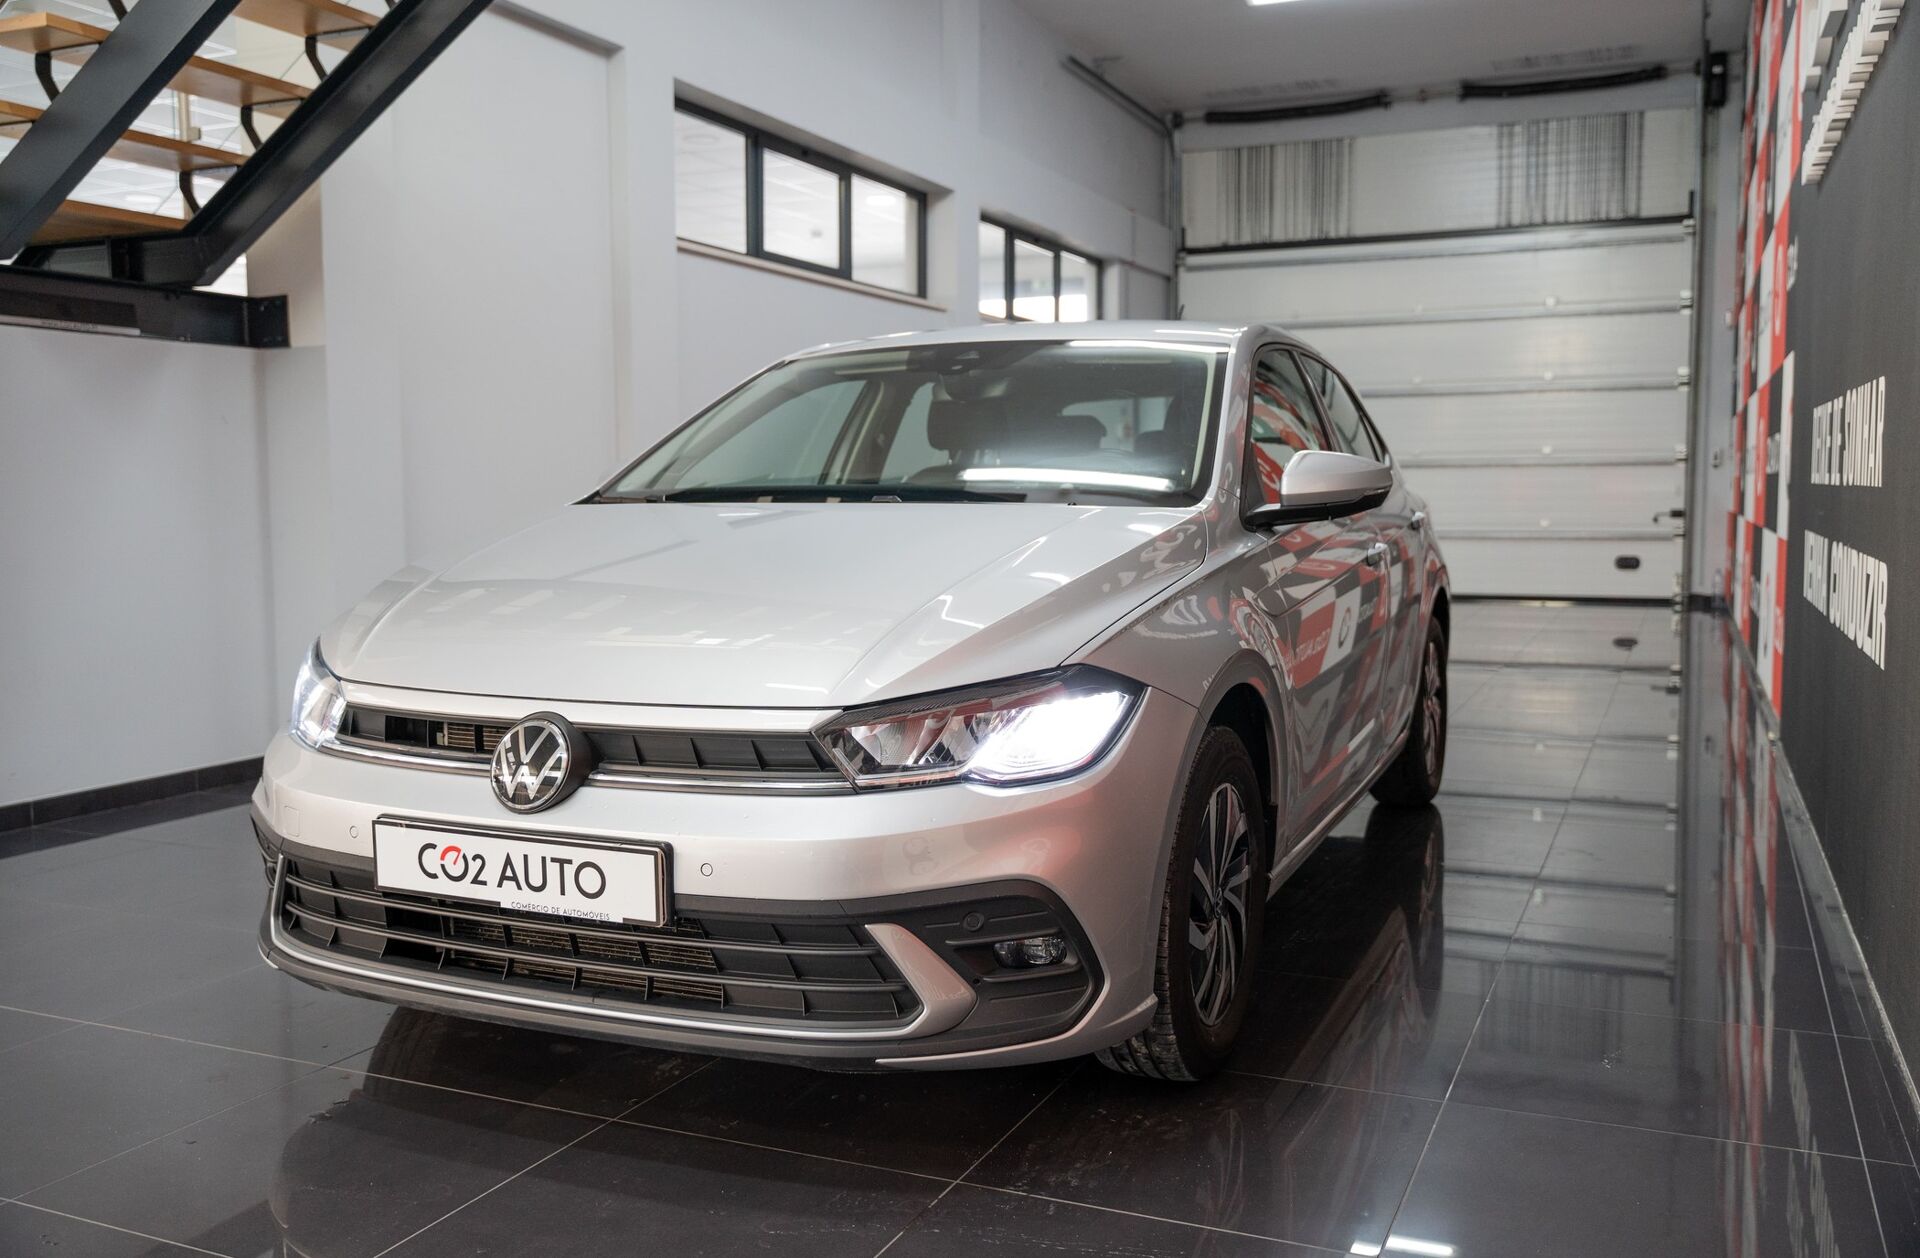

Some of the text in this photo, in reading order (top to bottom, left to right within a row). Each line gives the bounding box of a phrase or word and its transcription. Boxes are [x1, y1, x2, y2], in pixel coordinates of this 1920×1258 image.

[1843, 376, 1886, 487] SONHAR
[1829, 541, 1888, 671] CONDUZIR
[418, 842, 607, 900] CO2 AUTO
[551, 906, 560, 914] DE
